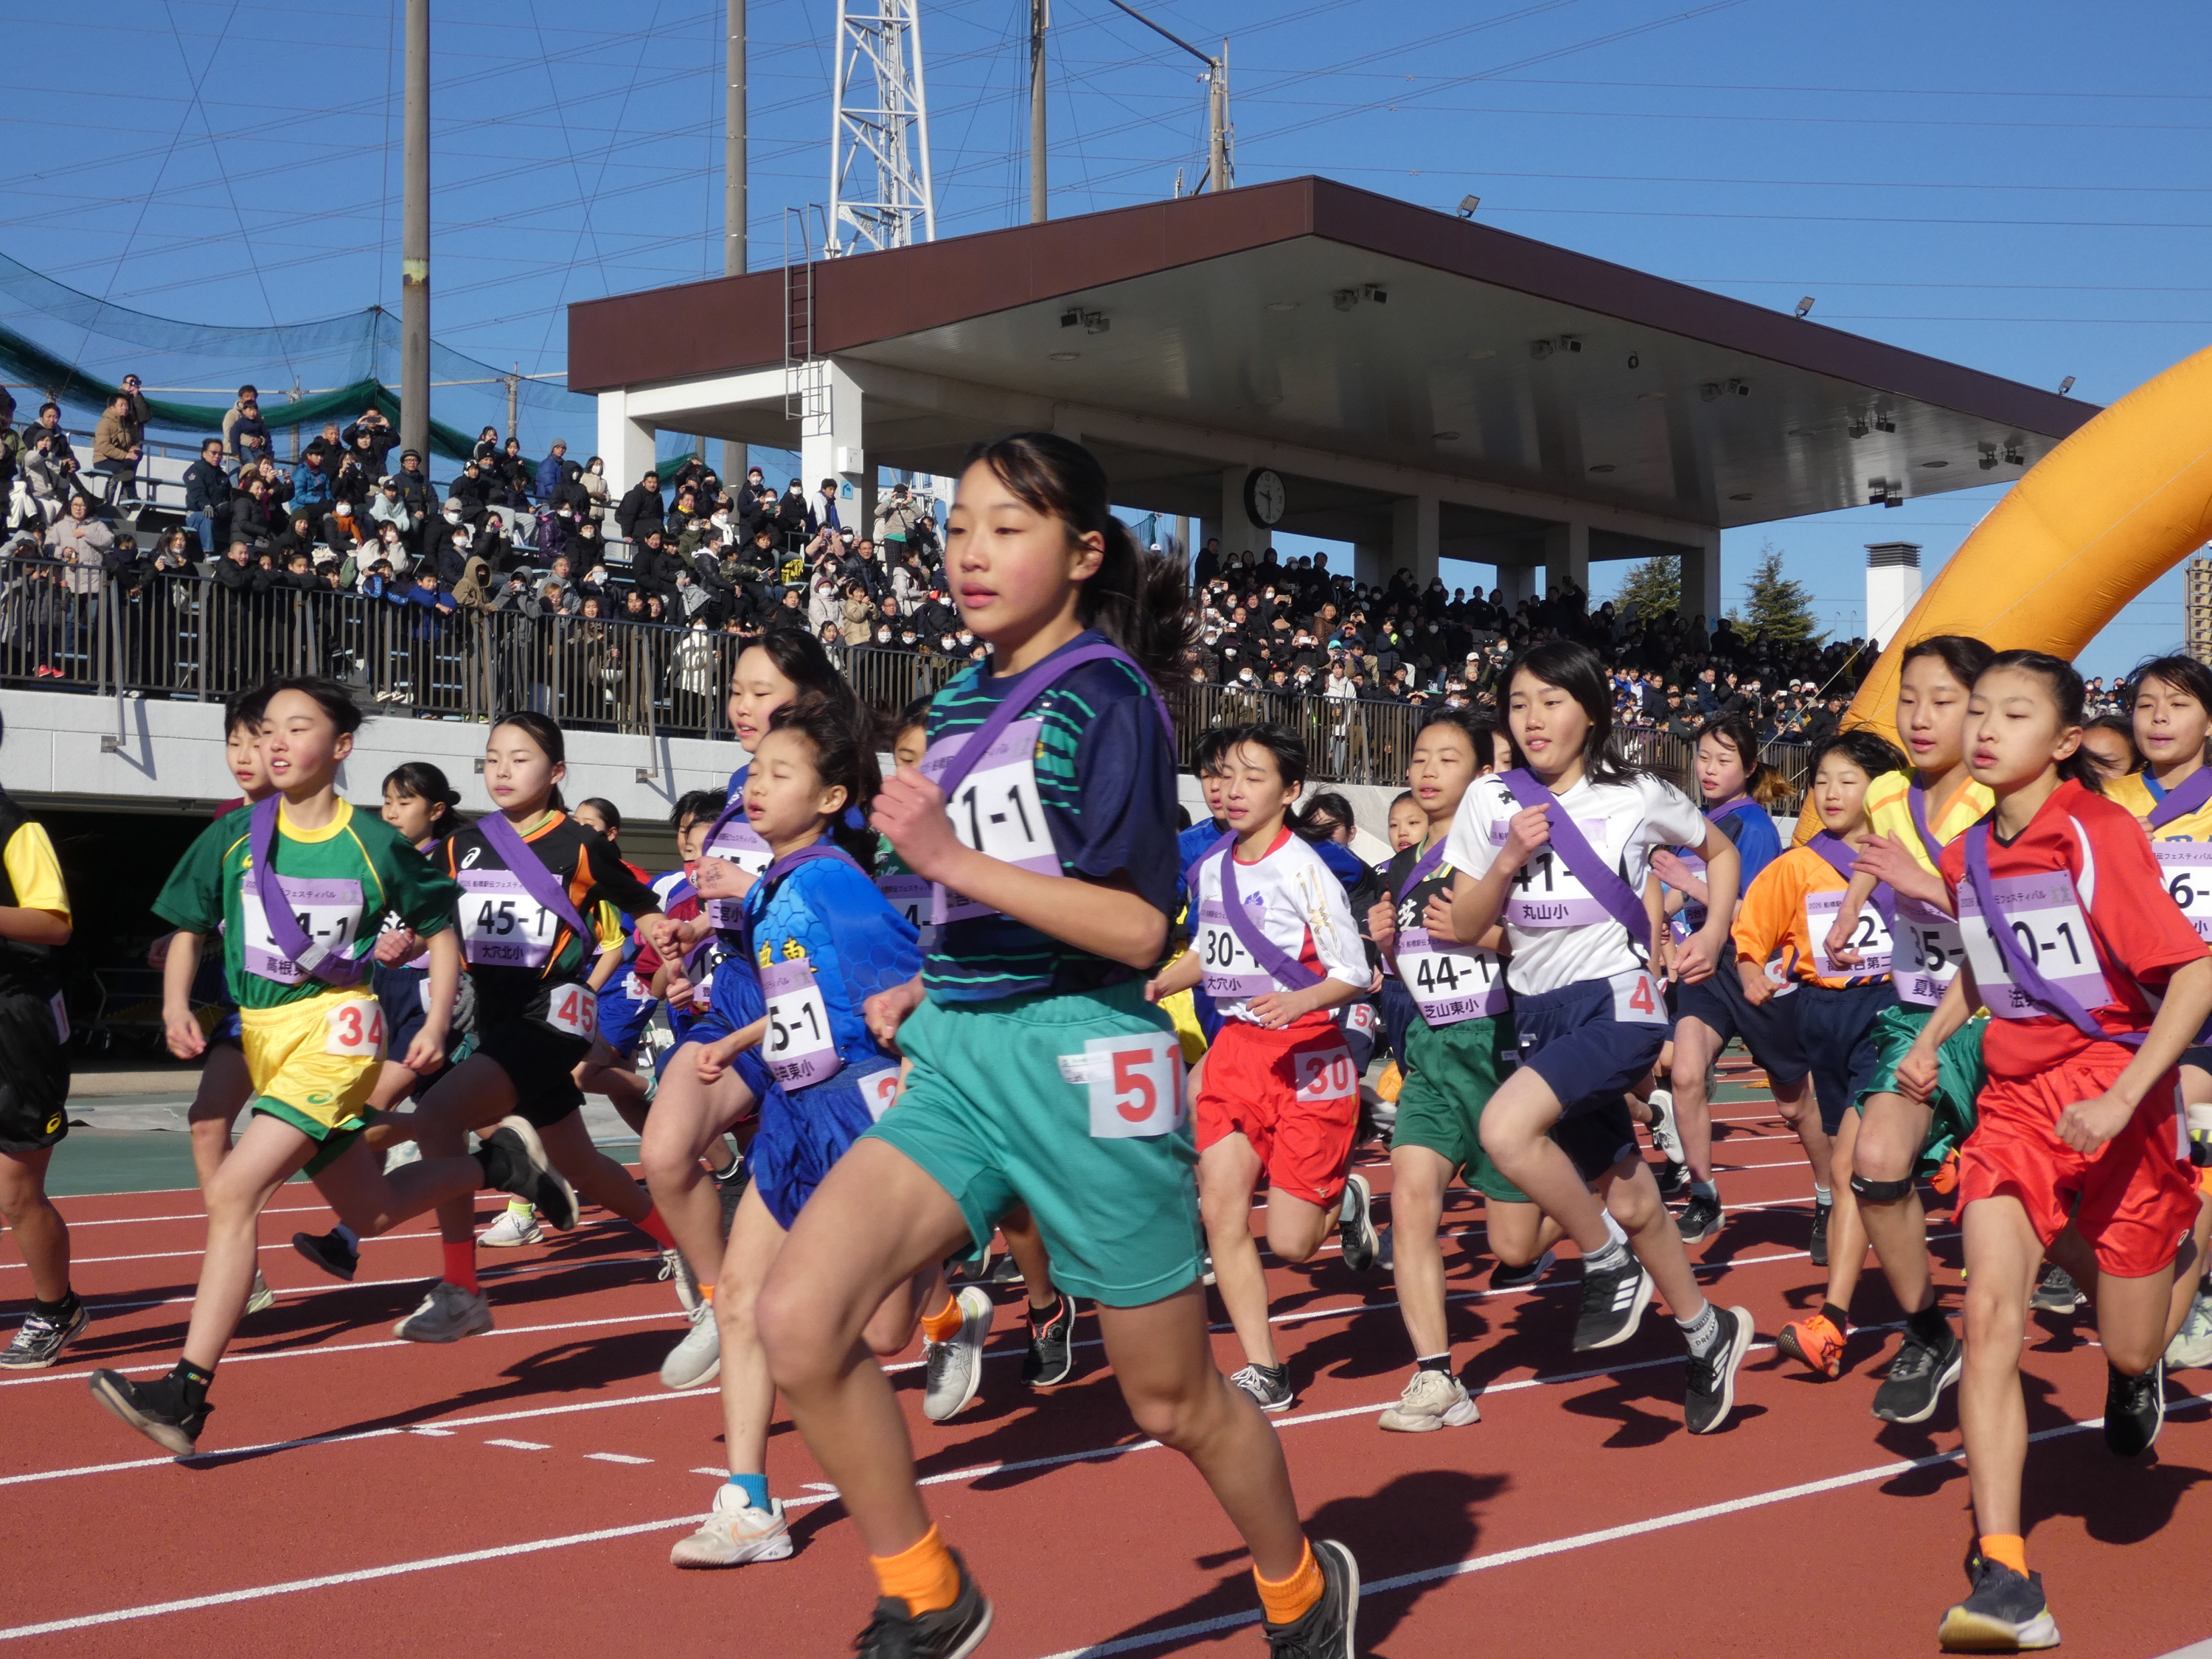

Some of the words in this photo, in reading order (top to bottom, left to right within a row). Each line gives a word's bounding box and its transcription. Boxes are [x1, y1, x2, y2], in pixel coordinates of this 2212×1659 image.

[267, 912, 349, 946] 4-1
[477, 900, 547, 937] 45-1
[1523, 904, 1569, 920] 丸山小
[482, 945, 524, 961] 大穴北小
[1206, 930, 1259, 968] 30-
[1207, 977, 1242, 992] 大穴小
[1417, 953, 1491, 993] 44-1
[558, 990, 594, 1032] 45
[1424, 998, 1480, 1019] 芝山東小
[1112, 1044, 1180, 1123] 51
[1306, 1054, 1349, 1095] 30
